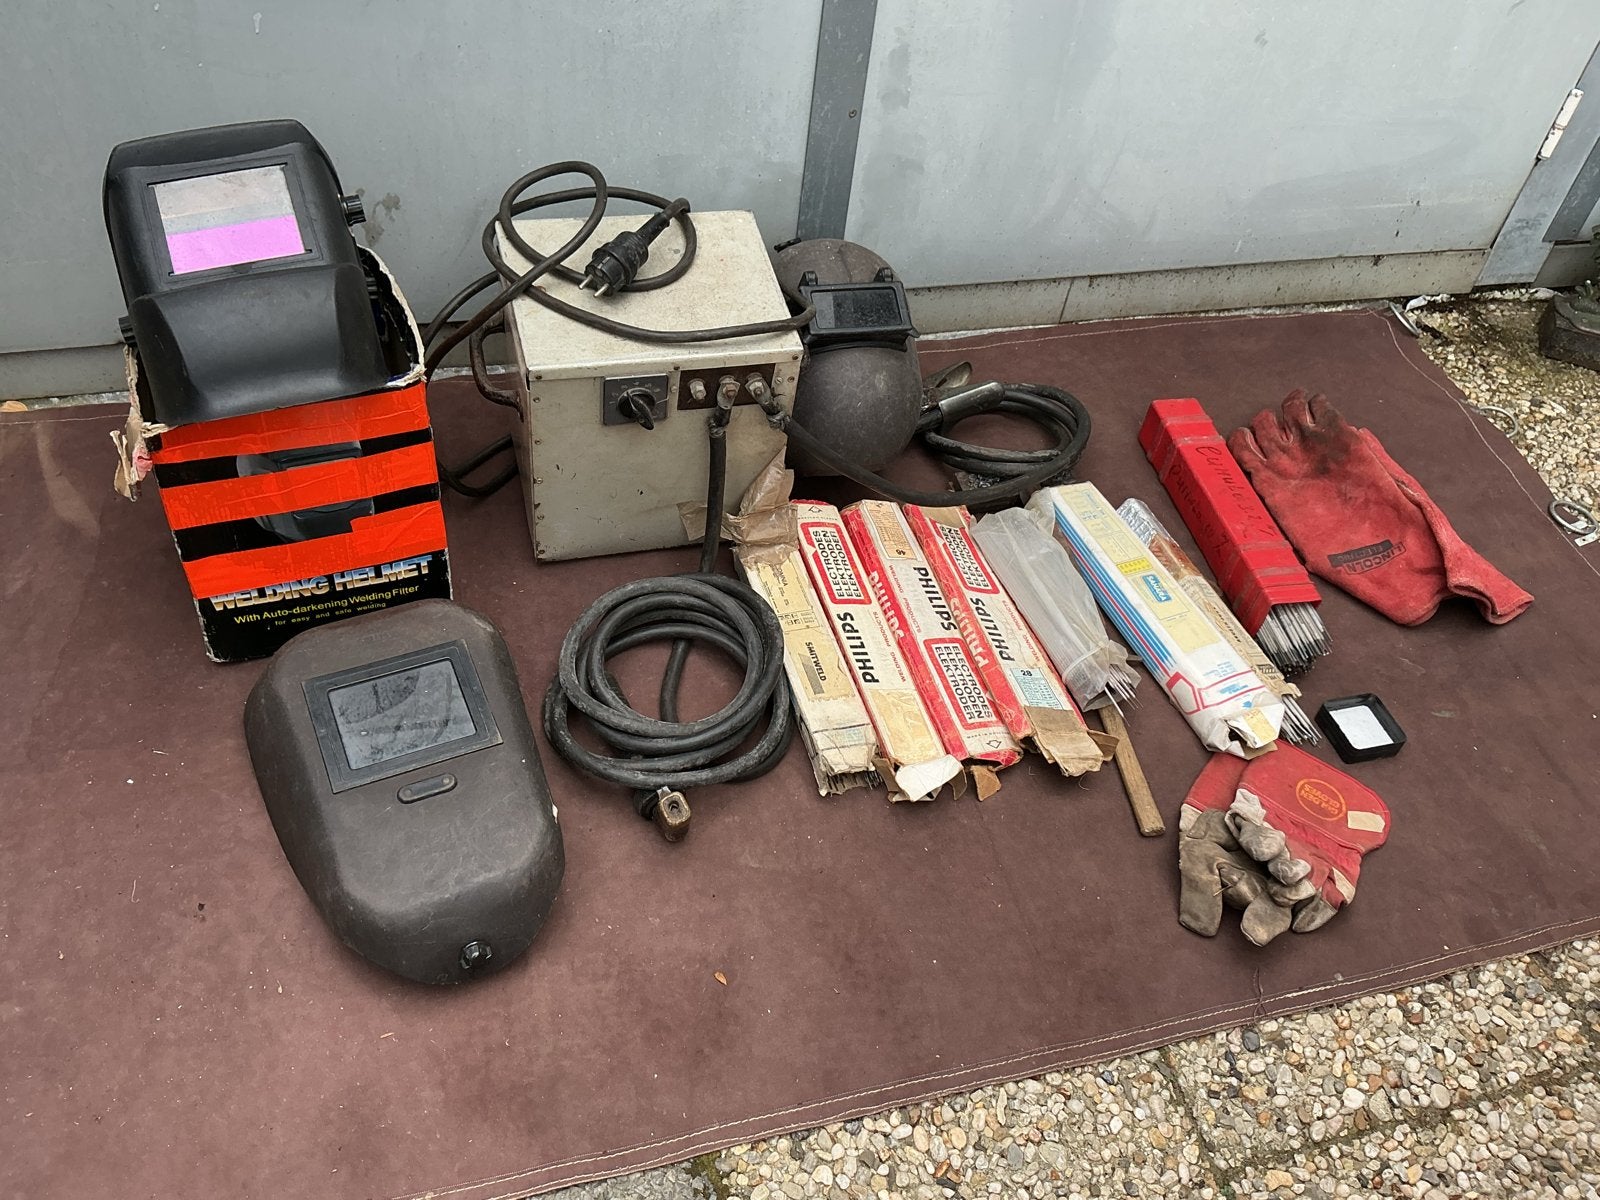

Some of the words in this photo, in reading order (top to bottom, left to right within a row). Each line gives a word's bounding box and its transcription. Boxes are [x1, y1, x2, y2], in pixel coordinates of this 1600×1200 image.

[209, 576, 330, 611] WELDING
[334, 555, 432, 591] HELMET
[813, 530, 844, 598] ELECTRODES
[822, 529, 853, 598] ELEKTRODEN
[940, 526, 975, 587] ELECTRODES
[946, 527, 982, 588] ELEKTRODEN
[952, 528, 989, 589] ELEKTRODER
[1350, 545, 1403, 573] LINCOLN
[234, 611, 260, 625] With
[262, 599, 348, 619] Auto-darkening
[349, 590, 391, 607] Welding
[392, 583, 420, 598] Filter
[274, 619, 287, 627] for
[291, 616, 311, 625] easy
[315, 612, 330, 621] and
[335, 608, 352, 617] safe
[356, 602, 387, 614] welding
[872, 611, 891, 648] PRODUCTS
[888, 564, 904, 595] WELDING
[901, 597, 922, 634] PRODUCTS
[914, 566, 958, 632] PHILIPS
[969, 597, 1015, 662] PHILIPS
[1003, 600, 1023, 633] PRODUCTS
[805, 641, 827, 682] SMITWELD
[836, 611, 880, 684] PHILIPS
[890, 651, 907, 683] WELDING
[1019, 669, 1033, 678] 28
[1023, 633, 1042, 662] WELDING
[935, 646, 976, 720] ELEKTRODER
[944, 645, 985, 720] ELEKTRODEN
[952, 645, 993, 719] ELECTRODES
